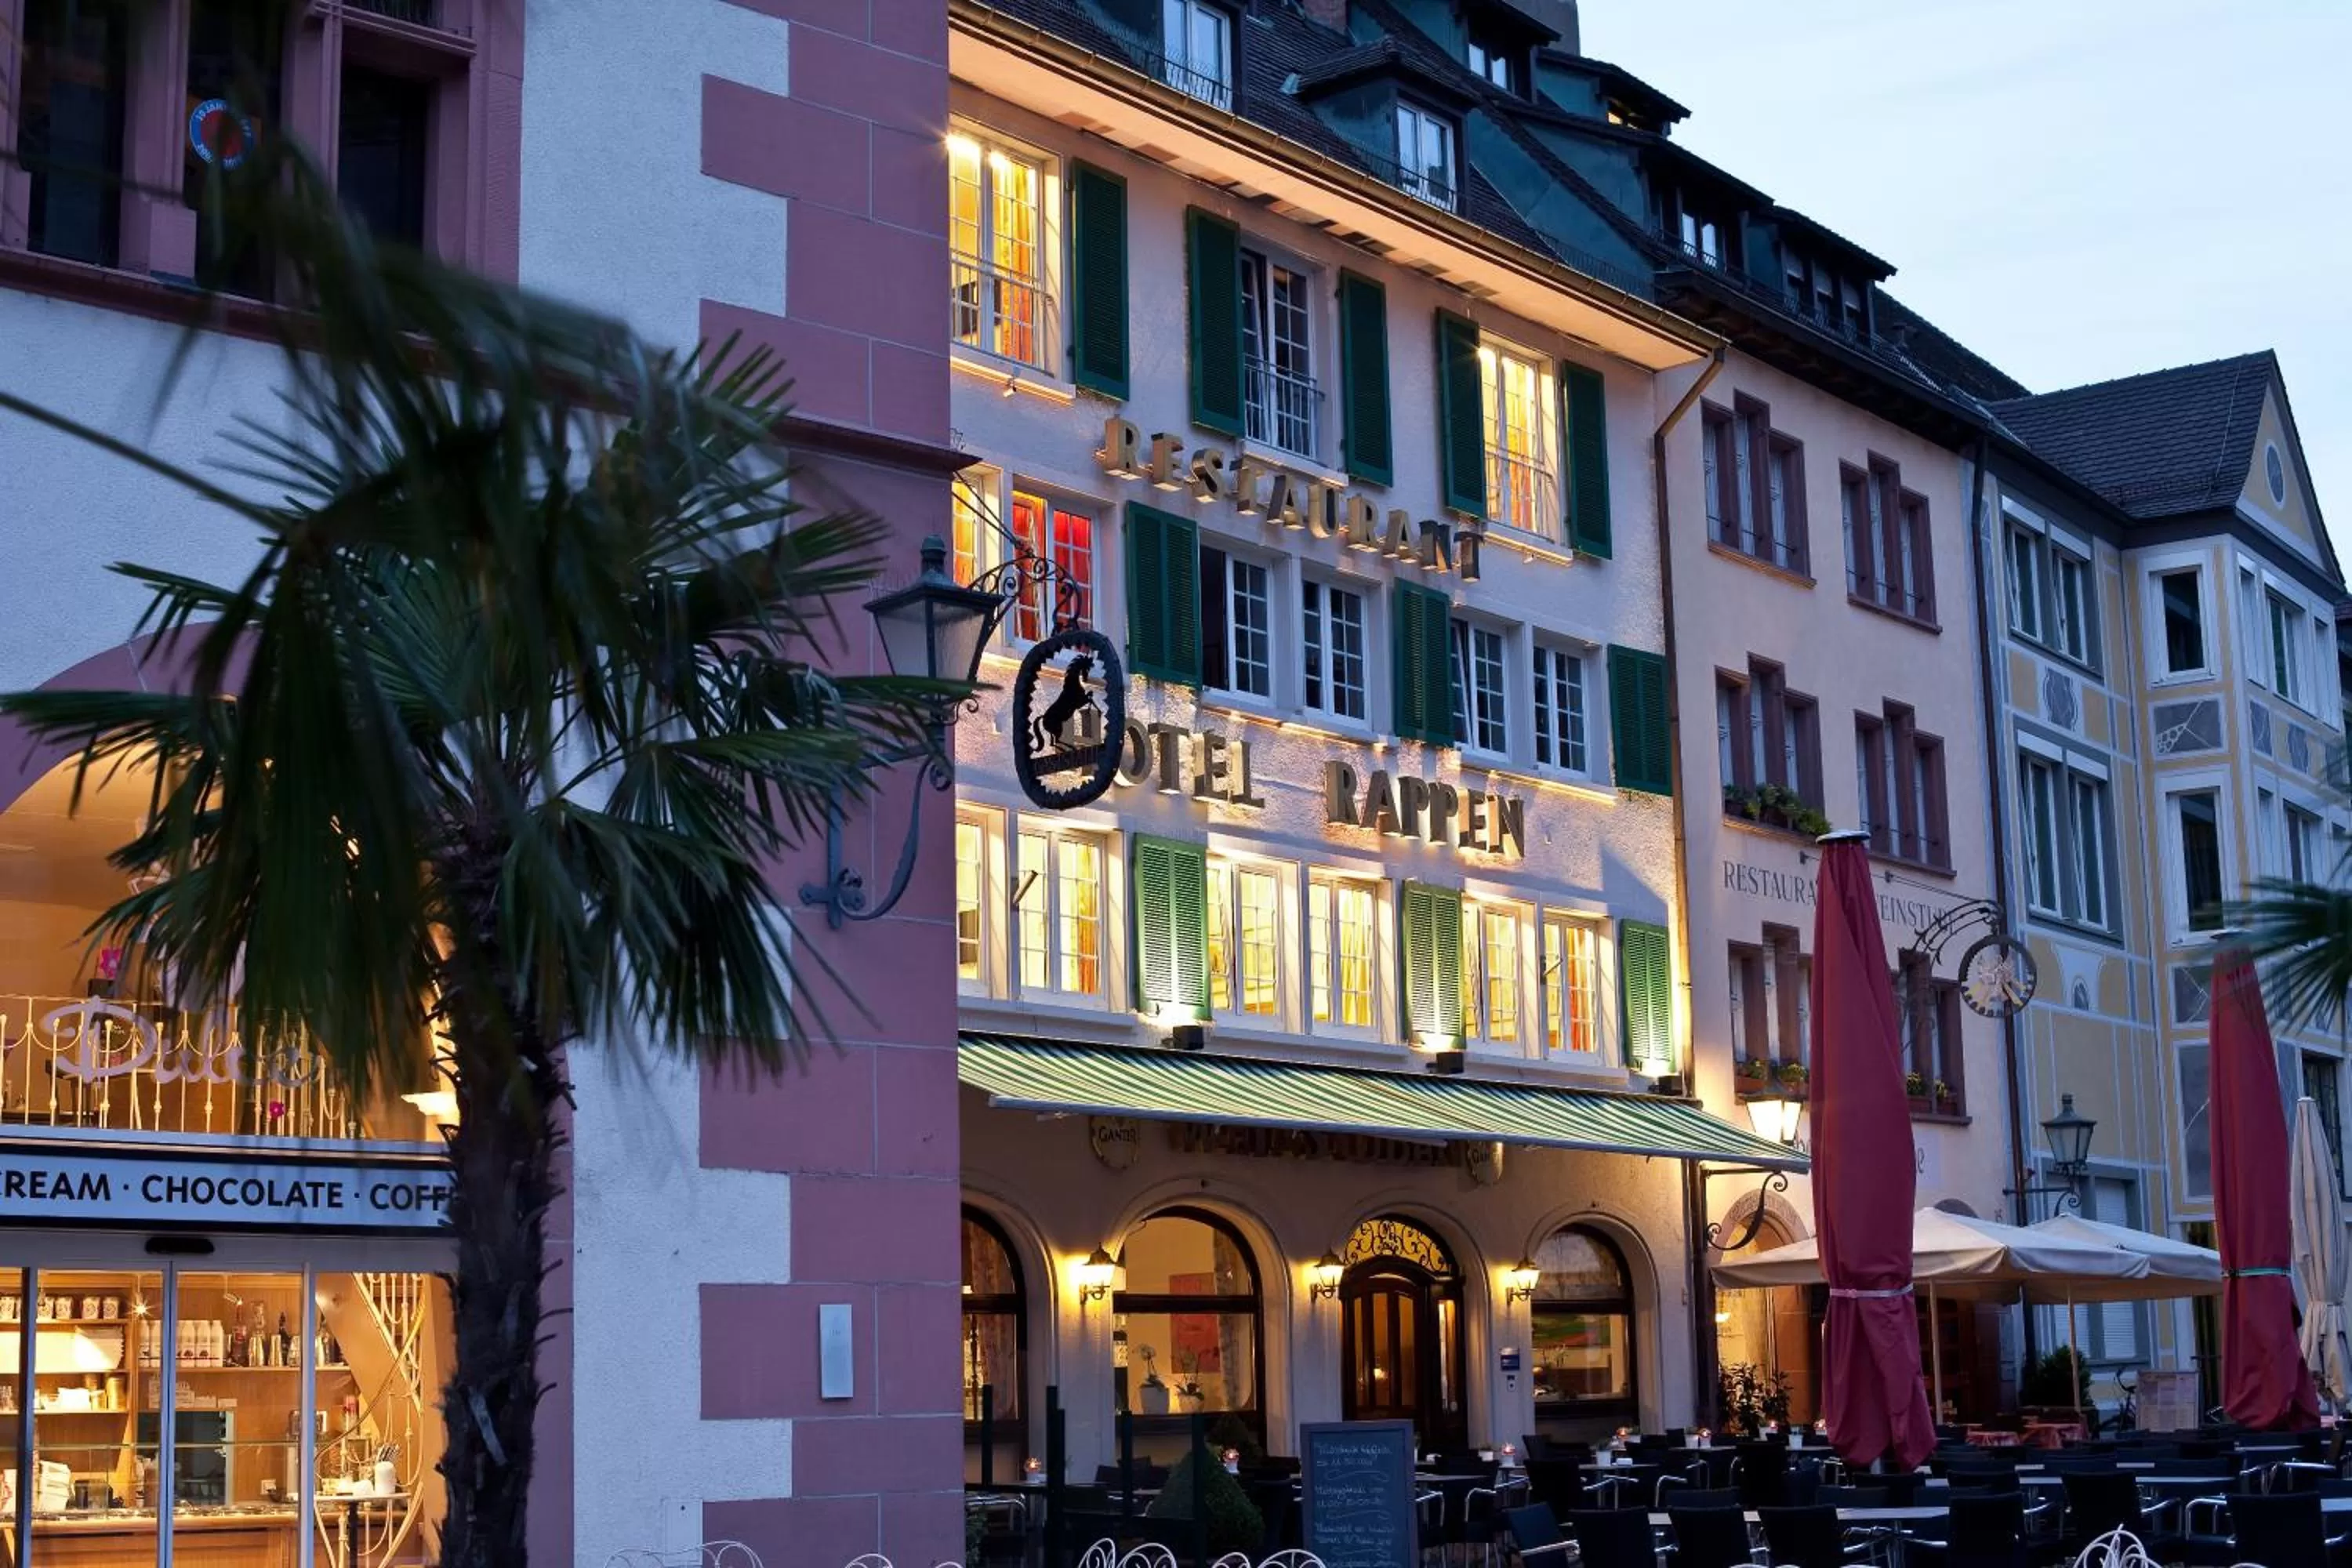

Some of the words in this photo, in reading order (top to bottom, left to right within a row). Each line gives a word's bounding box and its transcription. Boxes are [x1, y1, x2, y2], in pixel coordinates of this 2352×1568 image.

[1104, 415, 1485, 580] RESTAURANT
[1324, 759, 1525, 859] RAPPEN
[1722, 859, 1817, 906] RESTAURA
[0, 1170, 111, 1201] REAM
[141, 1174, 344, 1208] CHOCOLATE
[369, 1183, 451, 1211] COFF
